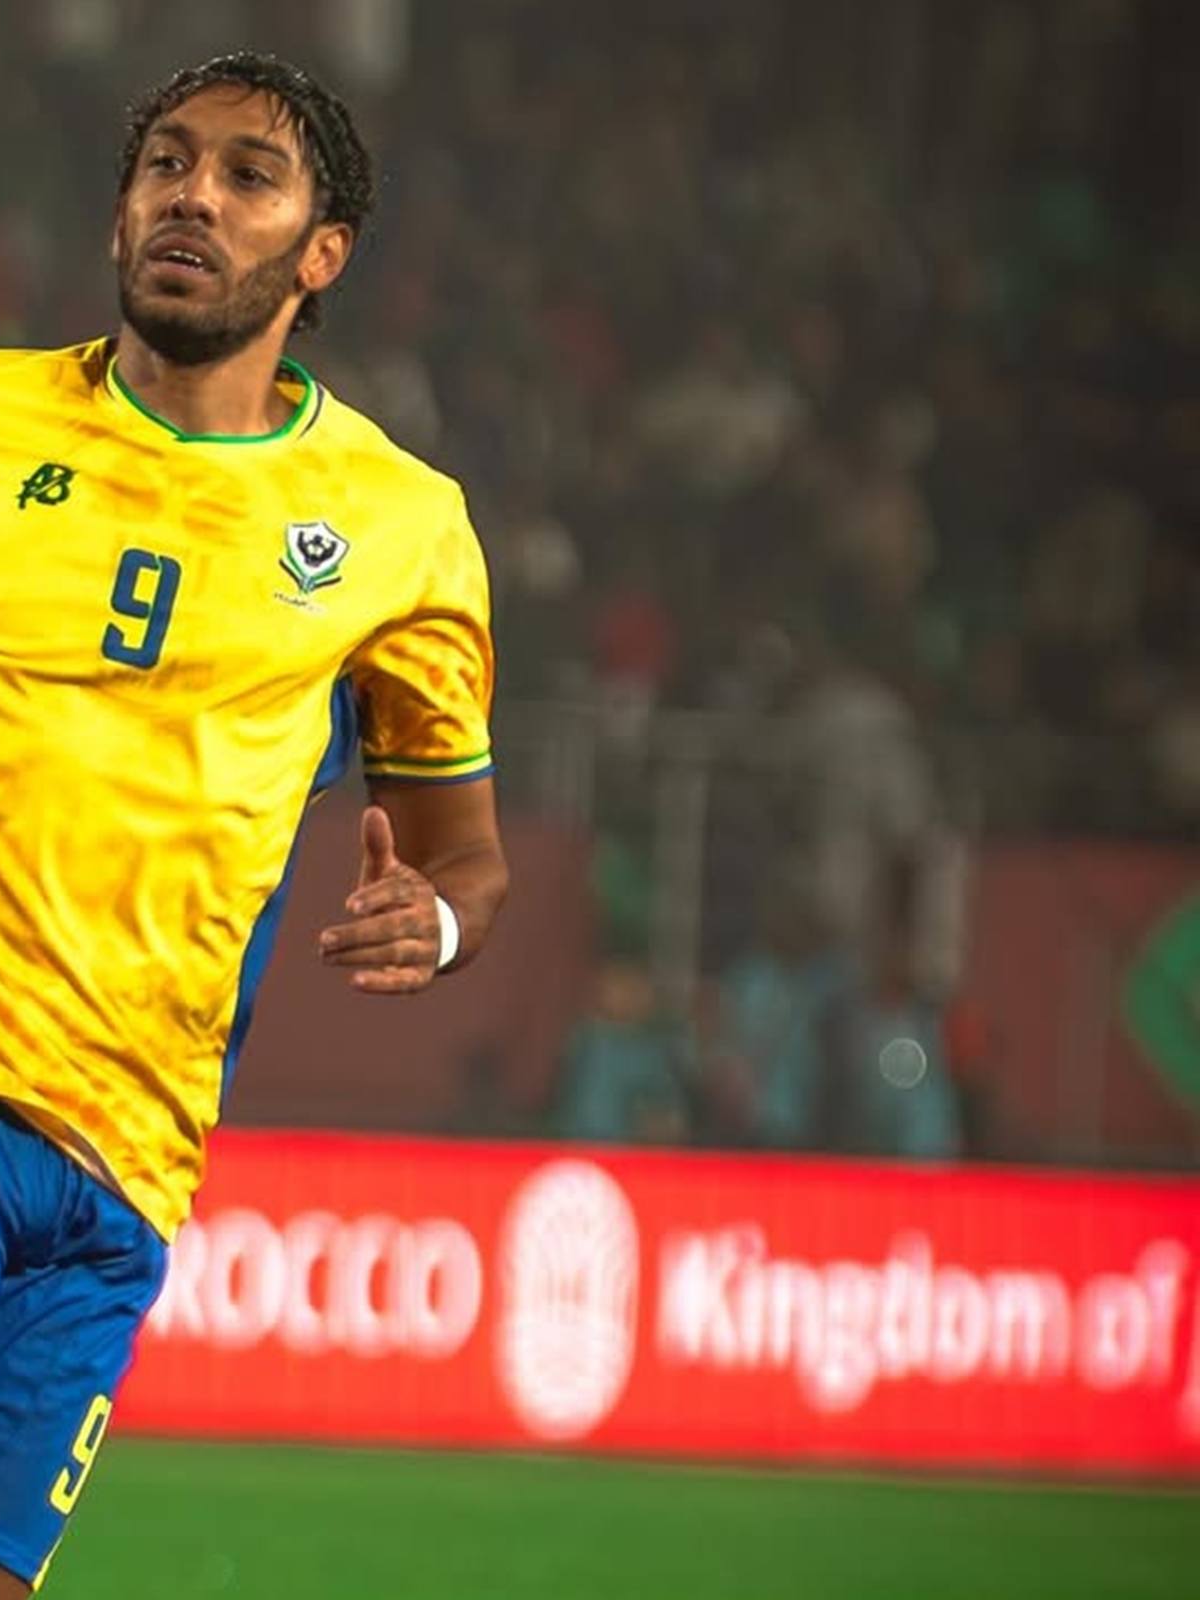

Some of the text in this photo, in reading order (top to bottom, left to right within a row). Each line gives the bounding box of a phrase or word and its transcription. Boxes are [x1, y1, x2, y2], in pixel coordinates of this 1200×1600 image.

[101, 548, 181, 670] 9
[146, 1208, 483, 1357] ROCCO
[657, 1221, 1074, 1414] Kingdom
[1077, 1236, 1190, 1392] of
[49, 1393, 113, 1516] 9
